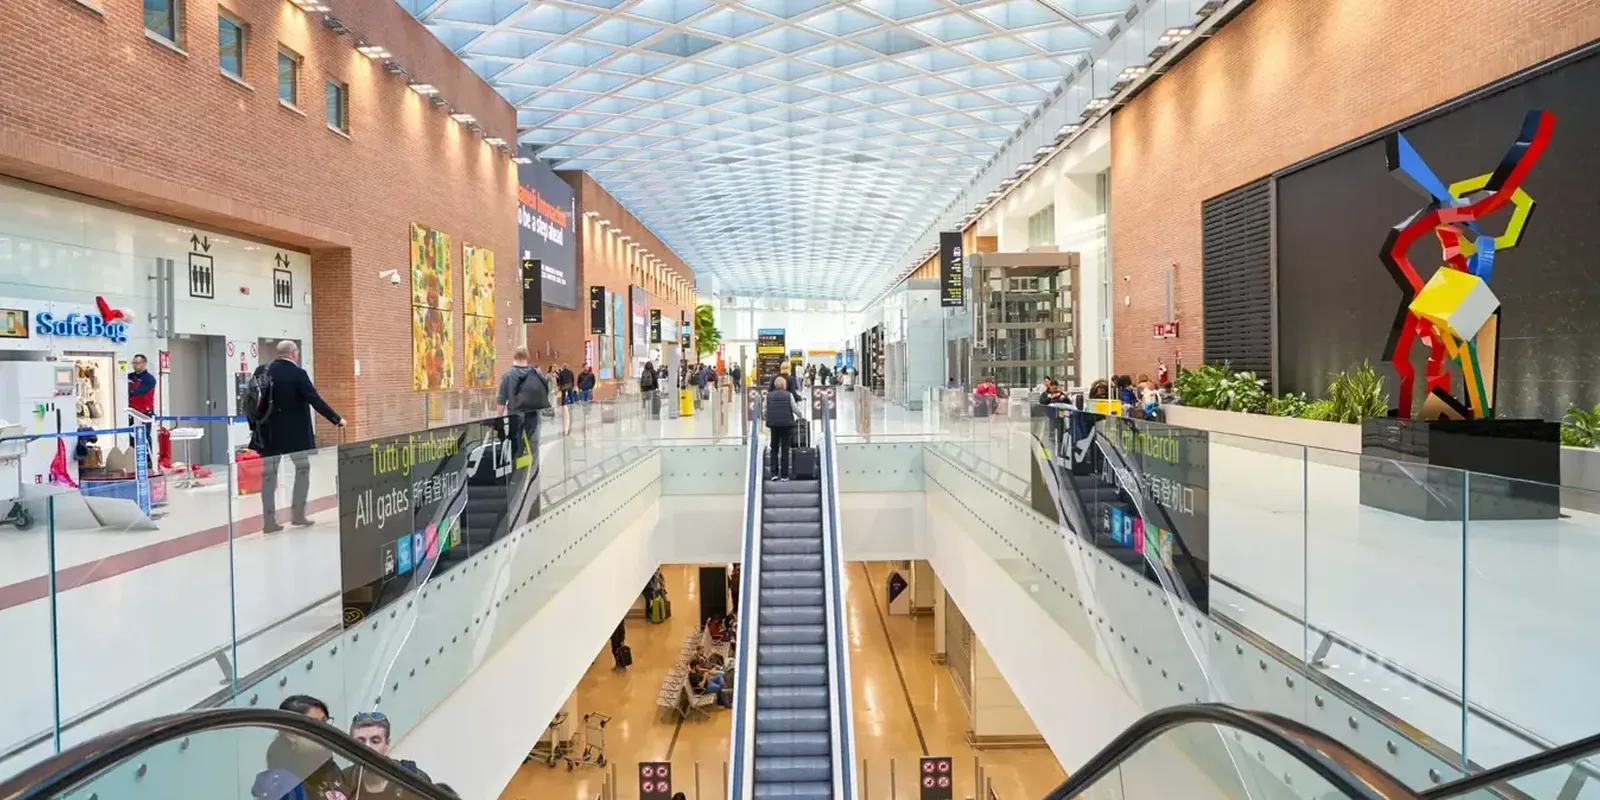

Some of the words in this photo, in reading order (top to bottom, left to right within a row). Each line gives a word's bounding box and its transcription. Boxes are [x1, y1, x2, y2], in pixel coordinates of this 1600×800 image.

[35, 311, 128, 343] SafeBag
[370, 439, 399, 476] Tutti
[402, 434, 415, 476] gli
[418, 428, 459, 464] imbarchi
[355, 489, 373, 529] All
[377, 487, 409, 529] gates
